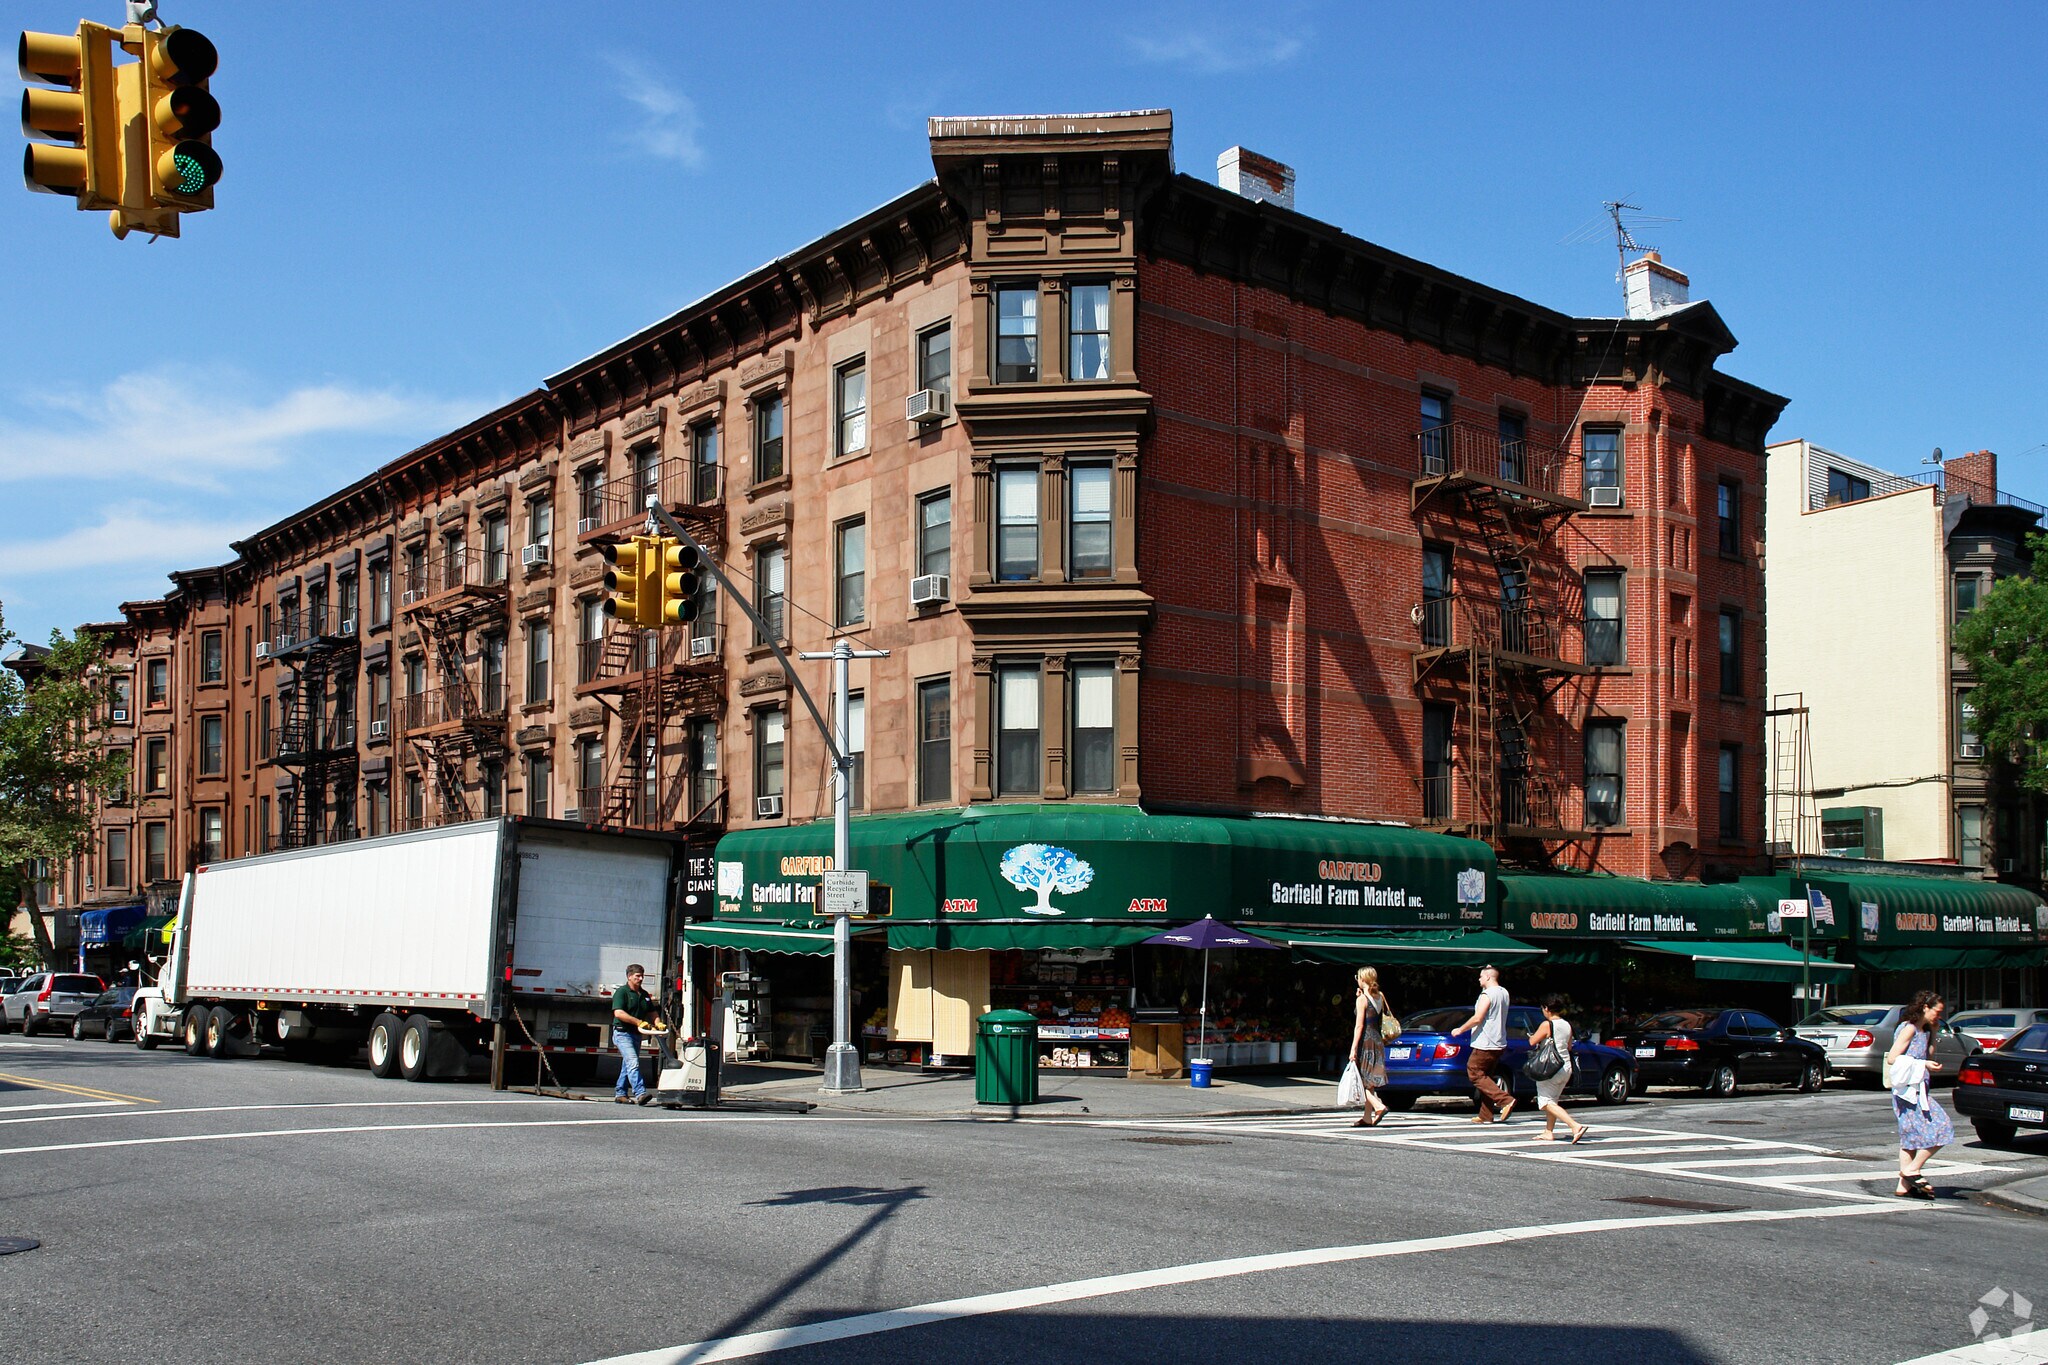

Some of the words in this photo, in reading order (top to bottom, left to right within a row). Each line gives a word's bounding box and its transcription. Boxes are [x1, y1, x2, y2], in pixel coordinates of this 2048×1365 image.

[688, 858, 705, 876] THE
[780, 855, 835, 876] GARFIELD
[1318, 859, 1382, 882] GARFIELD
[752, 883, 791, 903] Garfield
[1272, 882, 1323, 905] Garfield
[1327, 884, 1359, 905] Farm
[1363, 886, 1406, 907] Market
[1408, 896, 1424, 908] INC.
[752, 904, 763, 913] 156
[941, 899, 978, 913] ATM
[1127, 898, 1168, 913] ATM
[1241, 907, 1254, 915] 156
[1503, 922, 1515, 930] 156
[1530, 912, 1578, 930] GARFIELD
[1589, 912, 1626, 931] Garfield
[1628, 913, 1652, 931] Farm
[1653, 915, 1684, 932] Market
[1895, 912, 1938, 932] GARFIELD
[1942, 915, 1974, 932] Garfield
[1974, 916, 1994, 932] Farm
[1995, 916, 2021, 932] Market
